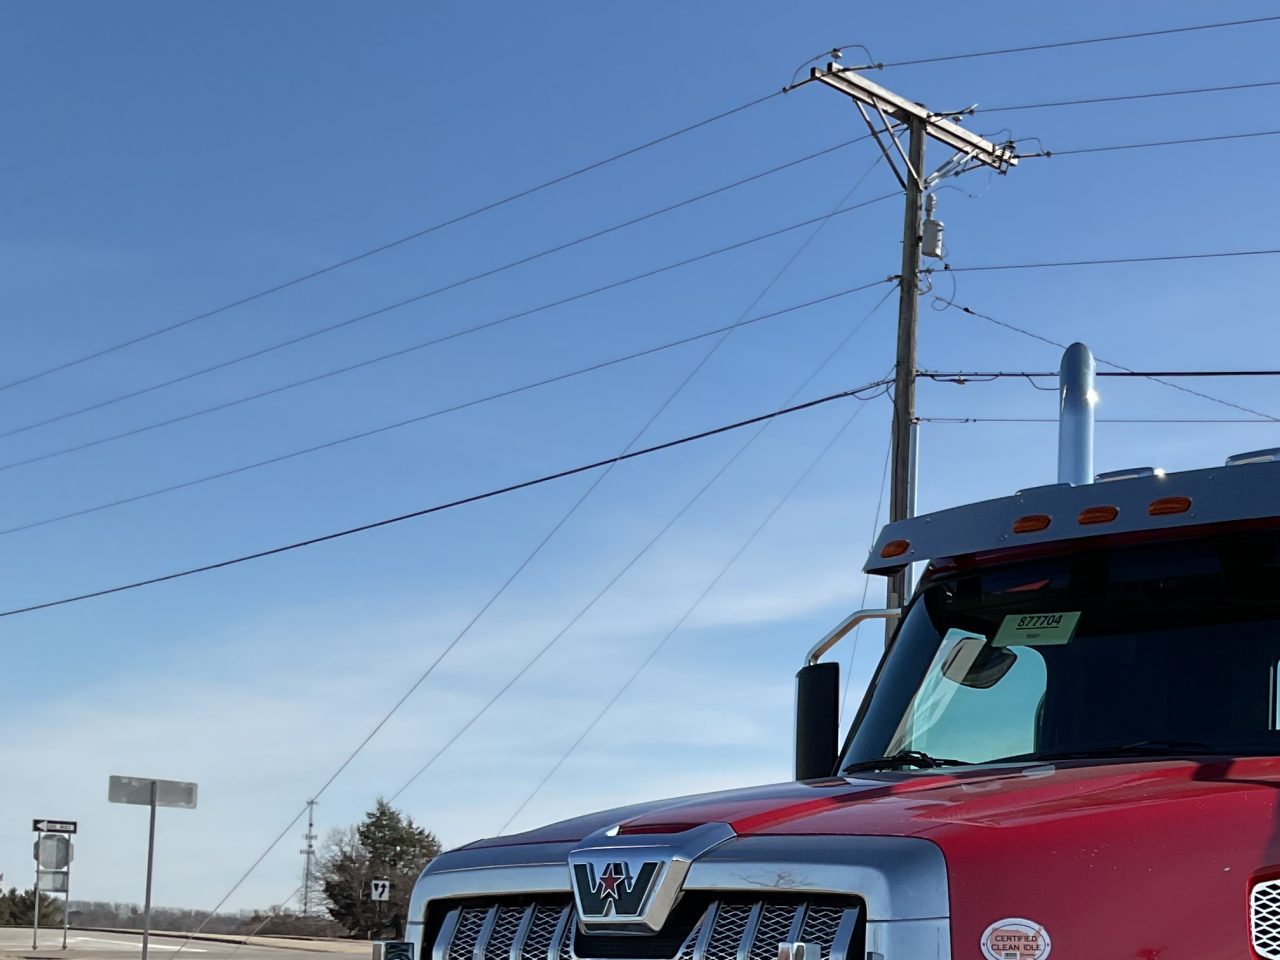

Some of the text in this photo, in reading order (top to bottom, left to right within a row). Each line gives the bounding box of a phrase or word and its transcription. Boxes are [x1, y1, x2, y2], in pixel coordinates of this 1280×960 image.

[1017, 614, 1064, 628] 877704
[991, 943, 1042, 951] CLEAN IDLE
